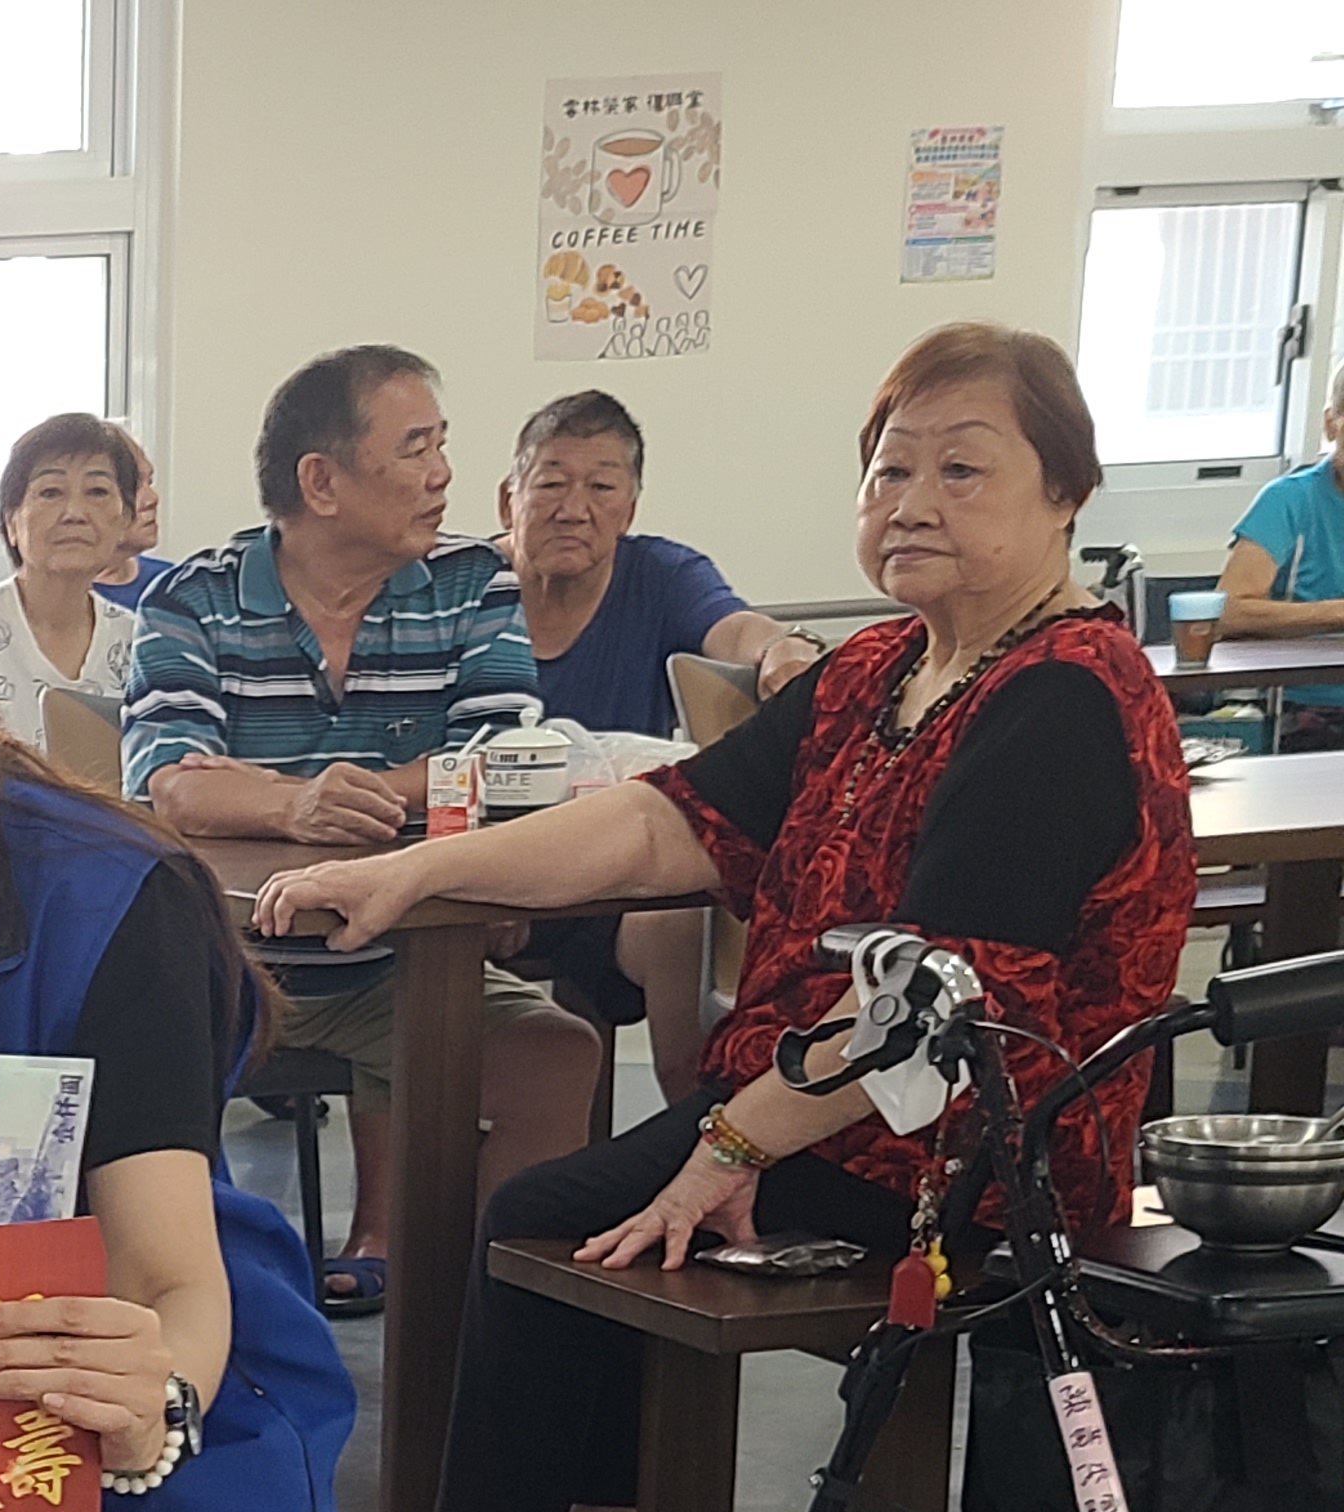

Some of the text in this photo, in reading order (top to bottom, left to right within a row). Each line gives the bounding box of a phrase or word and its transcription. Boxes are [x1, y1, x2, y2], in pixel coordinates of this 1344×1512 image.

[551, 219, 705, 249] COFFEE TIME
[51, 1074, 85, 1144] 壹仟圓
